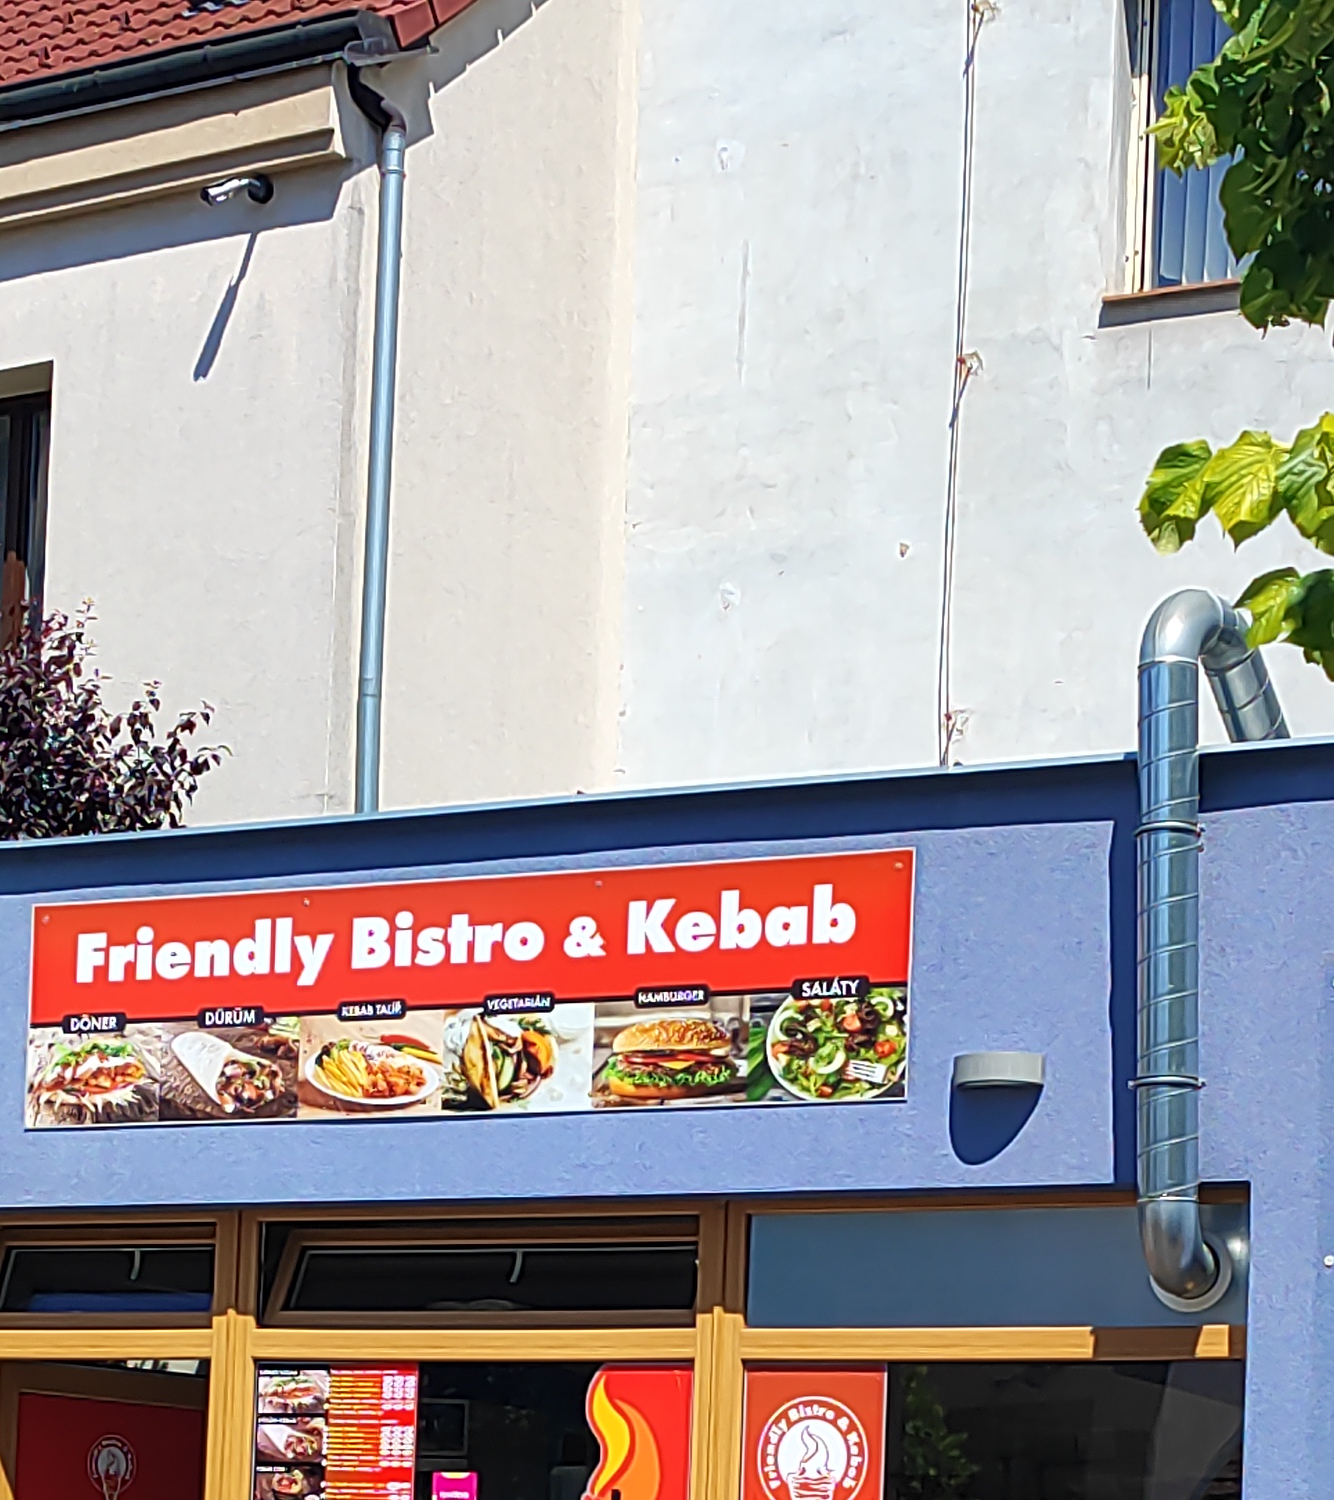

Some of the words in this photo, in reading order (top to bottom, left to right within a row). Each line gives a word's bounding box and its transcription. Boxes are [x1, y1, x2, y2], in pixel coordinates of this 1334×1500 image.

[75, 916, 335, 986] Friendly
[351, 910, 545, 970] Bistro
[563, 915, 607, 959] &
[626, 883, 857, 955] Kebab
[801, 976, 861, 998] SALÁTY
[638, 990, 705, 1005] HAMBURGER
[204, 1007, 256, 1026] DÜRÜM
[341, 1004, 374, 1017] KEBAB
[70, 1013, 117, 1032] DÖNER
[787, 1403, 836, 1423] Bistro
